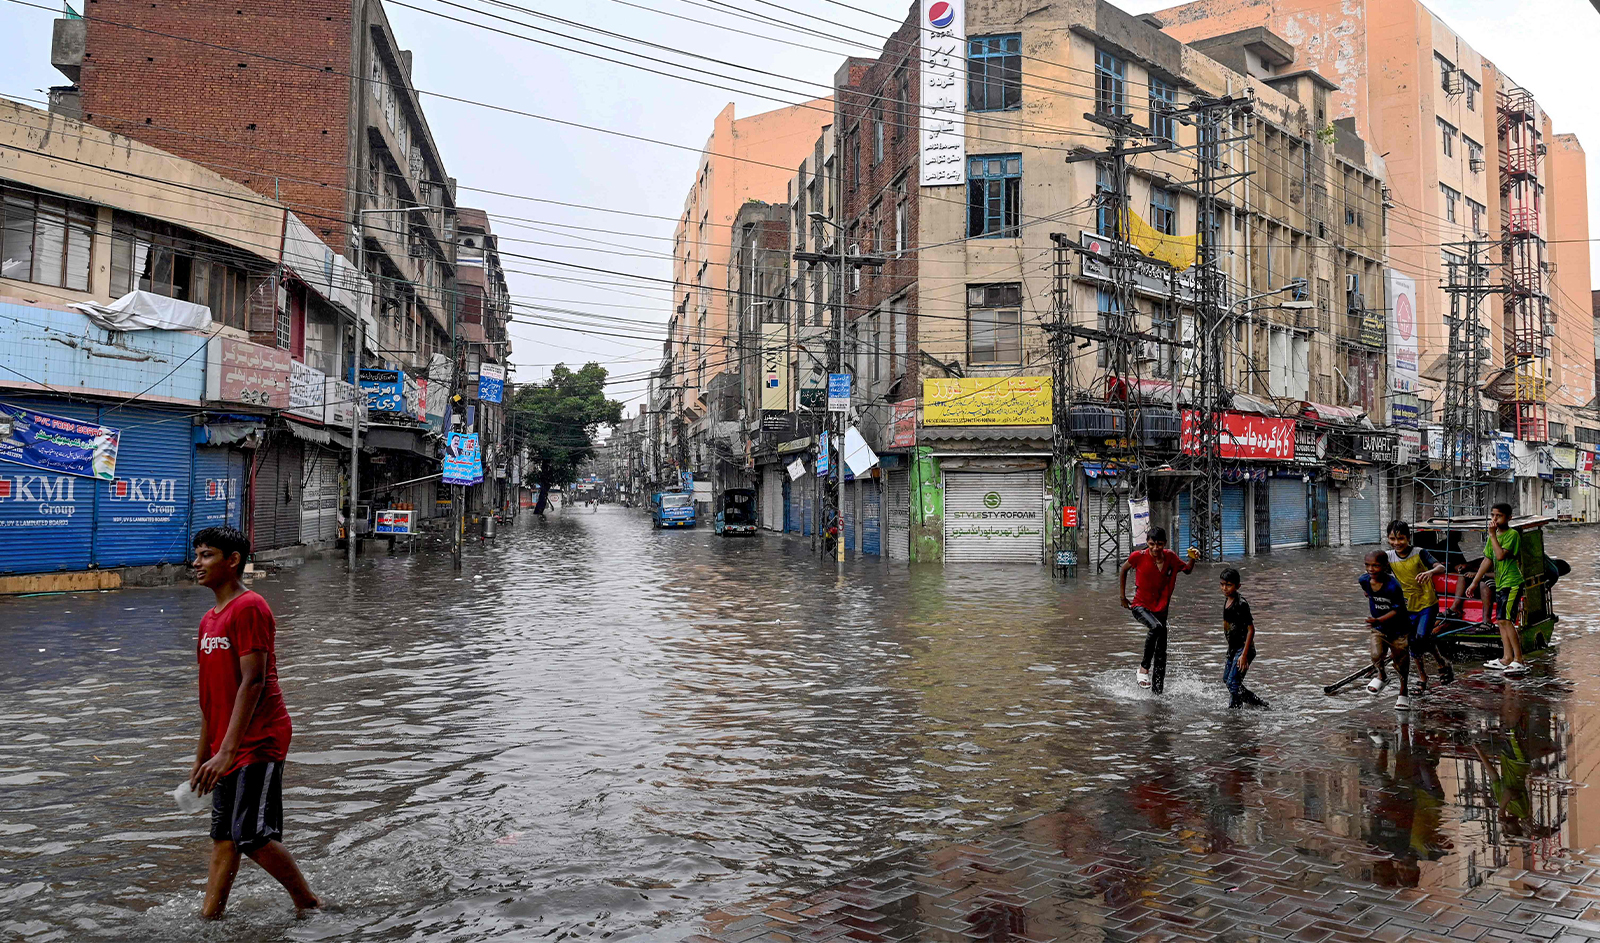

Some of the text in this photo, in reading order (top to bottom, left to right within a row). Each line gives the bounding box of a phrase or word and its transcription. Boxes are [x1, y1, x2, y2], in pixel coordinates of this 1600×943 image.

[34, 415, 51, 427] PVC
[52, 420, 75, 431] FOAM
[1257, 426, 1277, 454] گردہ
[1276, 421, 1295, 457] کاکا
[13, 475, 77, 502] KMI
[128, 477, 177, 503] KMI
[38, 502, 76, 517] Group
[147, 502, 176, 517] Group
